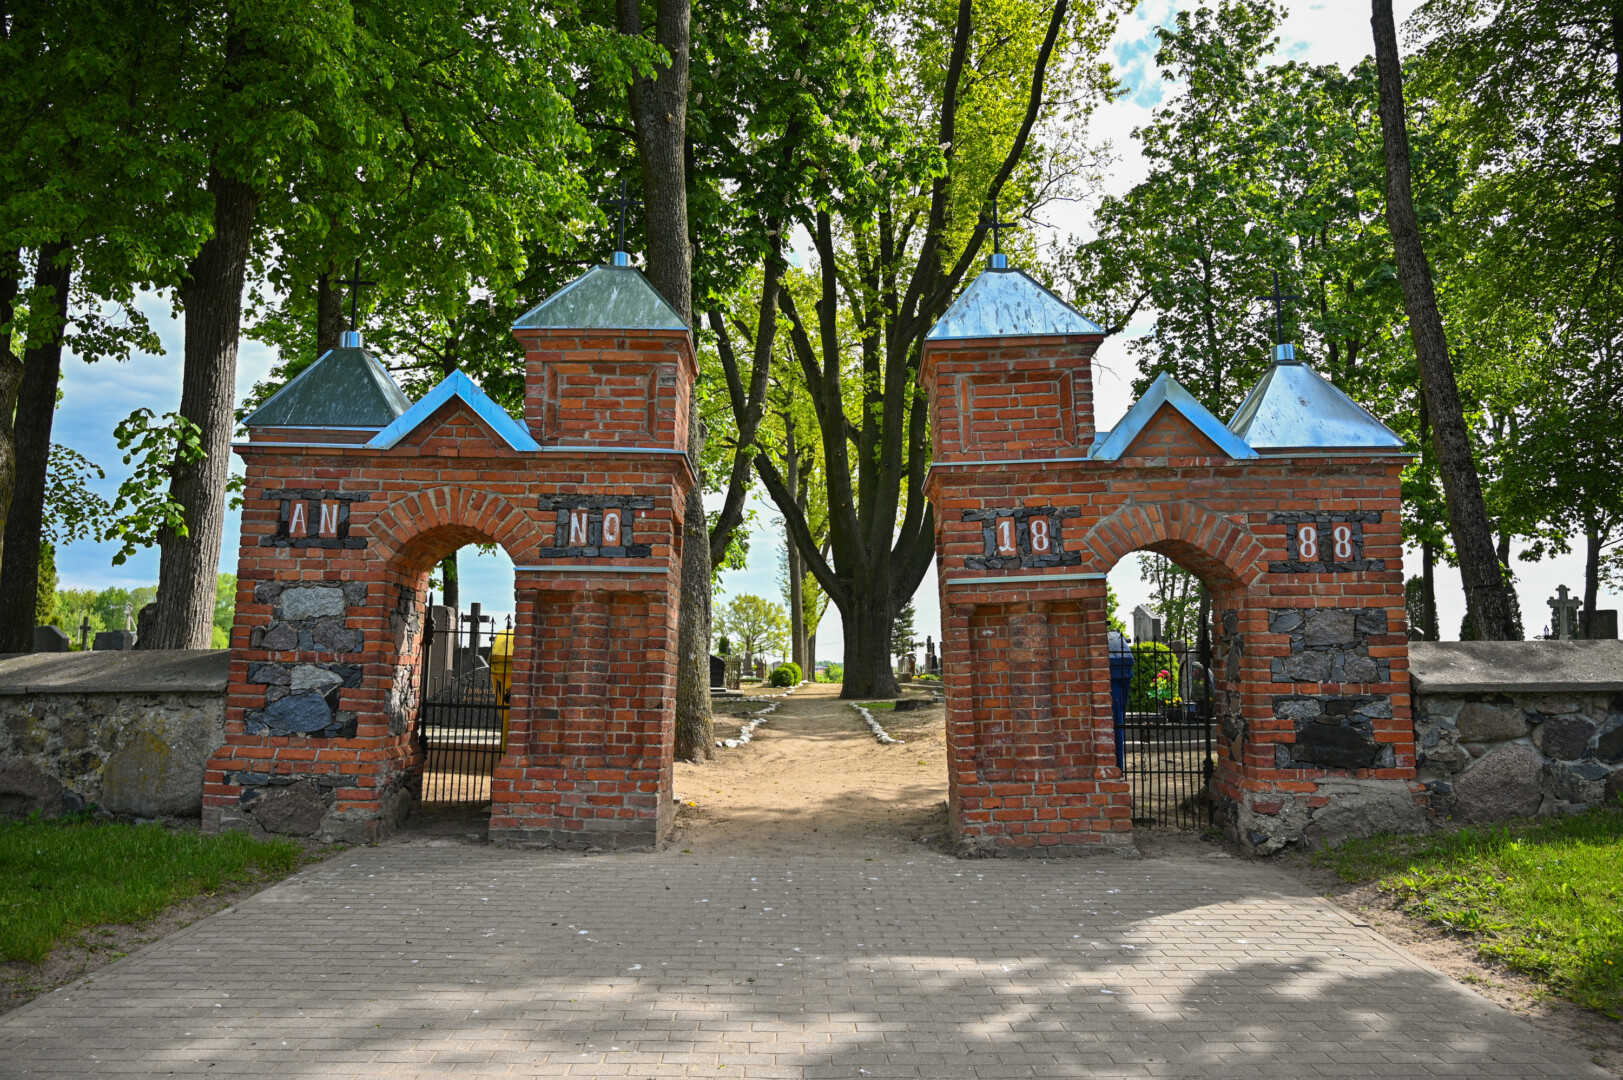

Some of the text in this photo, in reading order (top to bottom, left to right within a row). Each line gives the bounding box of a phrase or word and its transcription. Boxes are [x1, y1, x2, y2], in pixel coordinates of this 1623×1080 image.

[289, 503, 338, 533] AN
[570, 512, 619, 543] NO
[998, 520, 1049, 552] 18
[1299, 526, 1351, 558] 88
